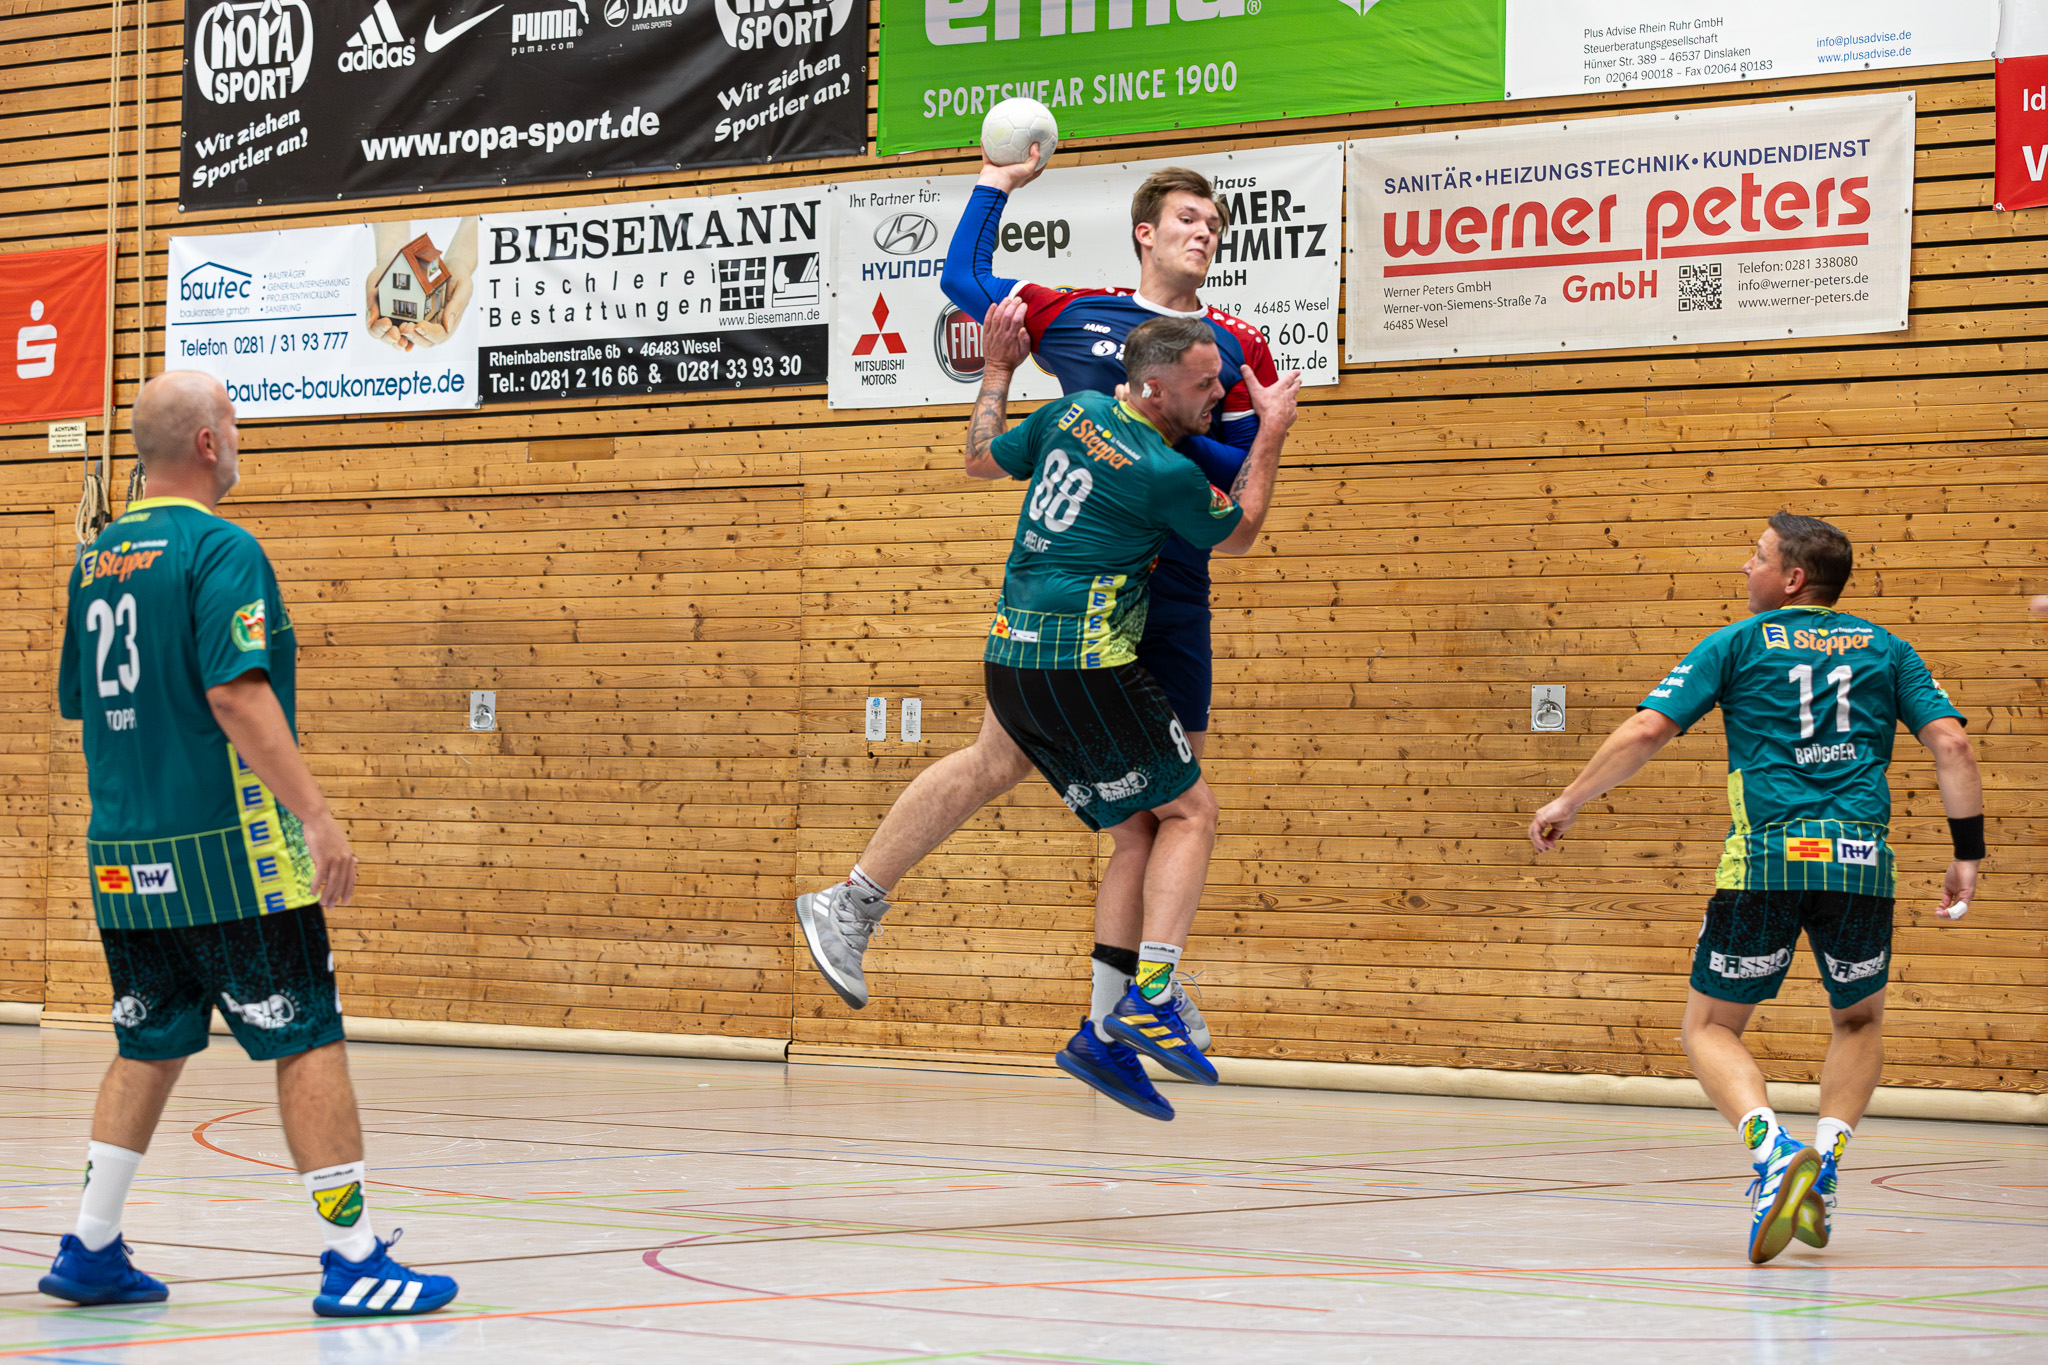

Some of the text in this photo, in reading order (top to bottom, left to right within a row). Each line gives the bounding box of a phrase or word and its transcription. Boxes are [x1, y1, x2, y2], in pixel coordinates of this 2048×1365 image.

[632, 0, 689, 20] JAKO
[512, 8, 577, 43] PUMA
[651, 20, 673, 30] SPORTS
[738, 9, 828, 50] SPORT
[1584, 17, 1724, 38] Plus Advise Rhein Ruhr GmbH
[511, 41, 574, 57] puma.com
[1583, 33, 1718, 54] Steuerberatungsgesellschaft
[1816, 30, 1912, 48] info@plusadvise.de
[338, 43, 416, 73] adidas
[1584, 58, 1617, 70] Hünxer
[1618, 56, 1635, 67] Str.
[1637, 54, 1657, 65] 389
[1668, 50, 1701, 62] 46537
[1703, 47, 1751, 60] Dinslaken
[1817, 46, 1912, 63] www.plusadvise.de
[214, 66, 291, 104] SPORT
[717, 53, 841, 111] Wir ziehen
[1583, 74, 1601, 84] Fon
[1606, 72, 1638, 83] 02064
[1641, 68, 1674, 80] 90018
[1685, 66, 1702, 77] Fax
[1704, 63, 1737, 75] 02064
[1739, 59, 1773, 72] 80183
[923, 61, 1238, 119] SPORTSWEAR SINCE 1900
[714, 73, 851, 142] Sportler an!
[195, 109, 301, 159] Wir ziehen
[361, 106, 660, 162] www.ropa-sport.de
[192, 127, 308, 189] Sportler an!
[1703, 138, 1871, 169] KUNDENDIENST
[1213, 175, 1257, 190] haus
[849, 189, 941, 208] Ihr Partner für:
[1218, 189, 1306, 226] MER-
[1384, 172, 1871, 260] werner peters
[489, 200, 822, 265] BIESEMANN
[994, 219, 1071, 258] eep
[1214, 223, 1328, 264] HMITZ
[862, 258, 946, 281] HYUNDA
[1738, 255, 1859, 274] Telefon: 0281 338080
[181, 276, 252, 301] bautec
[489, 262, 717, 299] Tischlerei
[1199, 269, 1247, 289] mbH
[1384, 281, 1492, 298] Werner Peters GmbH
[1562, 269, 1658, 303] GmbH
[1738, 272, 1869, 291] info@werner-peters.de
[180, 305, 250, 318] baukonzepte gmbh
[489, 295, 712, 328] Bestattungen
[1254, 300, 1291, 314] 46485
[1294, 297, 1330, 311] Wesel
[1384, 294, 1547, 314] Werner-von-Siemens-Straße 7a
[1738, 290, 1869, 308] www.werner-peters.de
[719, 308, 821, 327] www.Biesemann.de
[1383, 316, 1448, 331] 46485 Wesel
[180, 337, 228, 357] Telefon
[234, 335, 265, 355] 0281
[281, 334, 296, 352] 31
[302, 333, 319, 350] 93
[323, 331, 349, 350] 777
[1278, 321, 1329, 345] 60-0
[489, 337, 721, 367] Rheinbabenstraße 6b 46483 Wesel
[854, 358, 905, 372] MITSUBISHI
[226, 368, 465, 402] bautec-baukonzepte.de
[489, 354, 801, 393] Tel.: 0281 2 16 66 & 0281 33 93 30
[861, 373, 897, 386] MOTORS
[1072, 419, 1133, 470] Stepper
[1028, 448, 1093, 533] 88
[95, 550, 164, 583] Stepper
[86, 593, 140, 698] 23
[1793, 629, 1875, 656] Stepper
[1788, 663, 1852, 739] 11
[1169, 720, 1192, 764] 8
[1794, 742, 1857, 765] BRÜGGER
